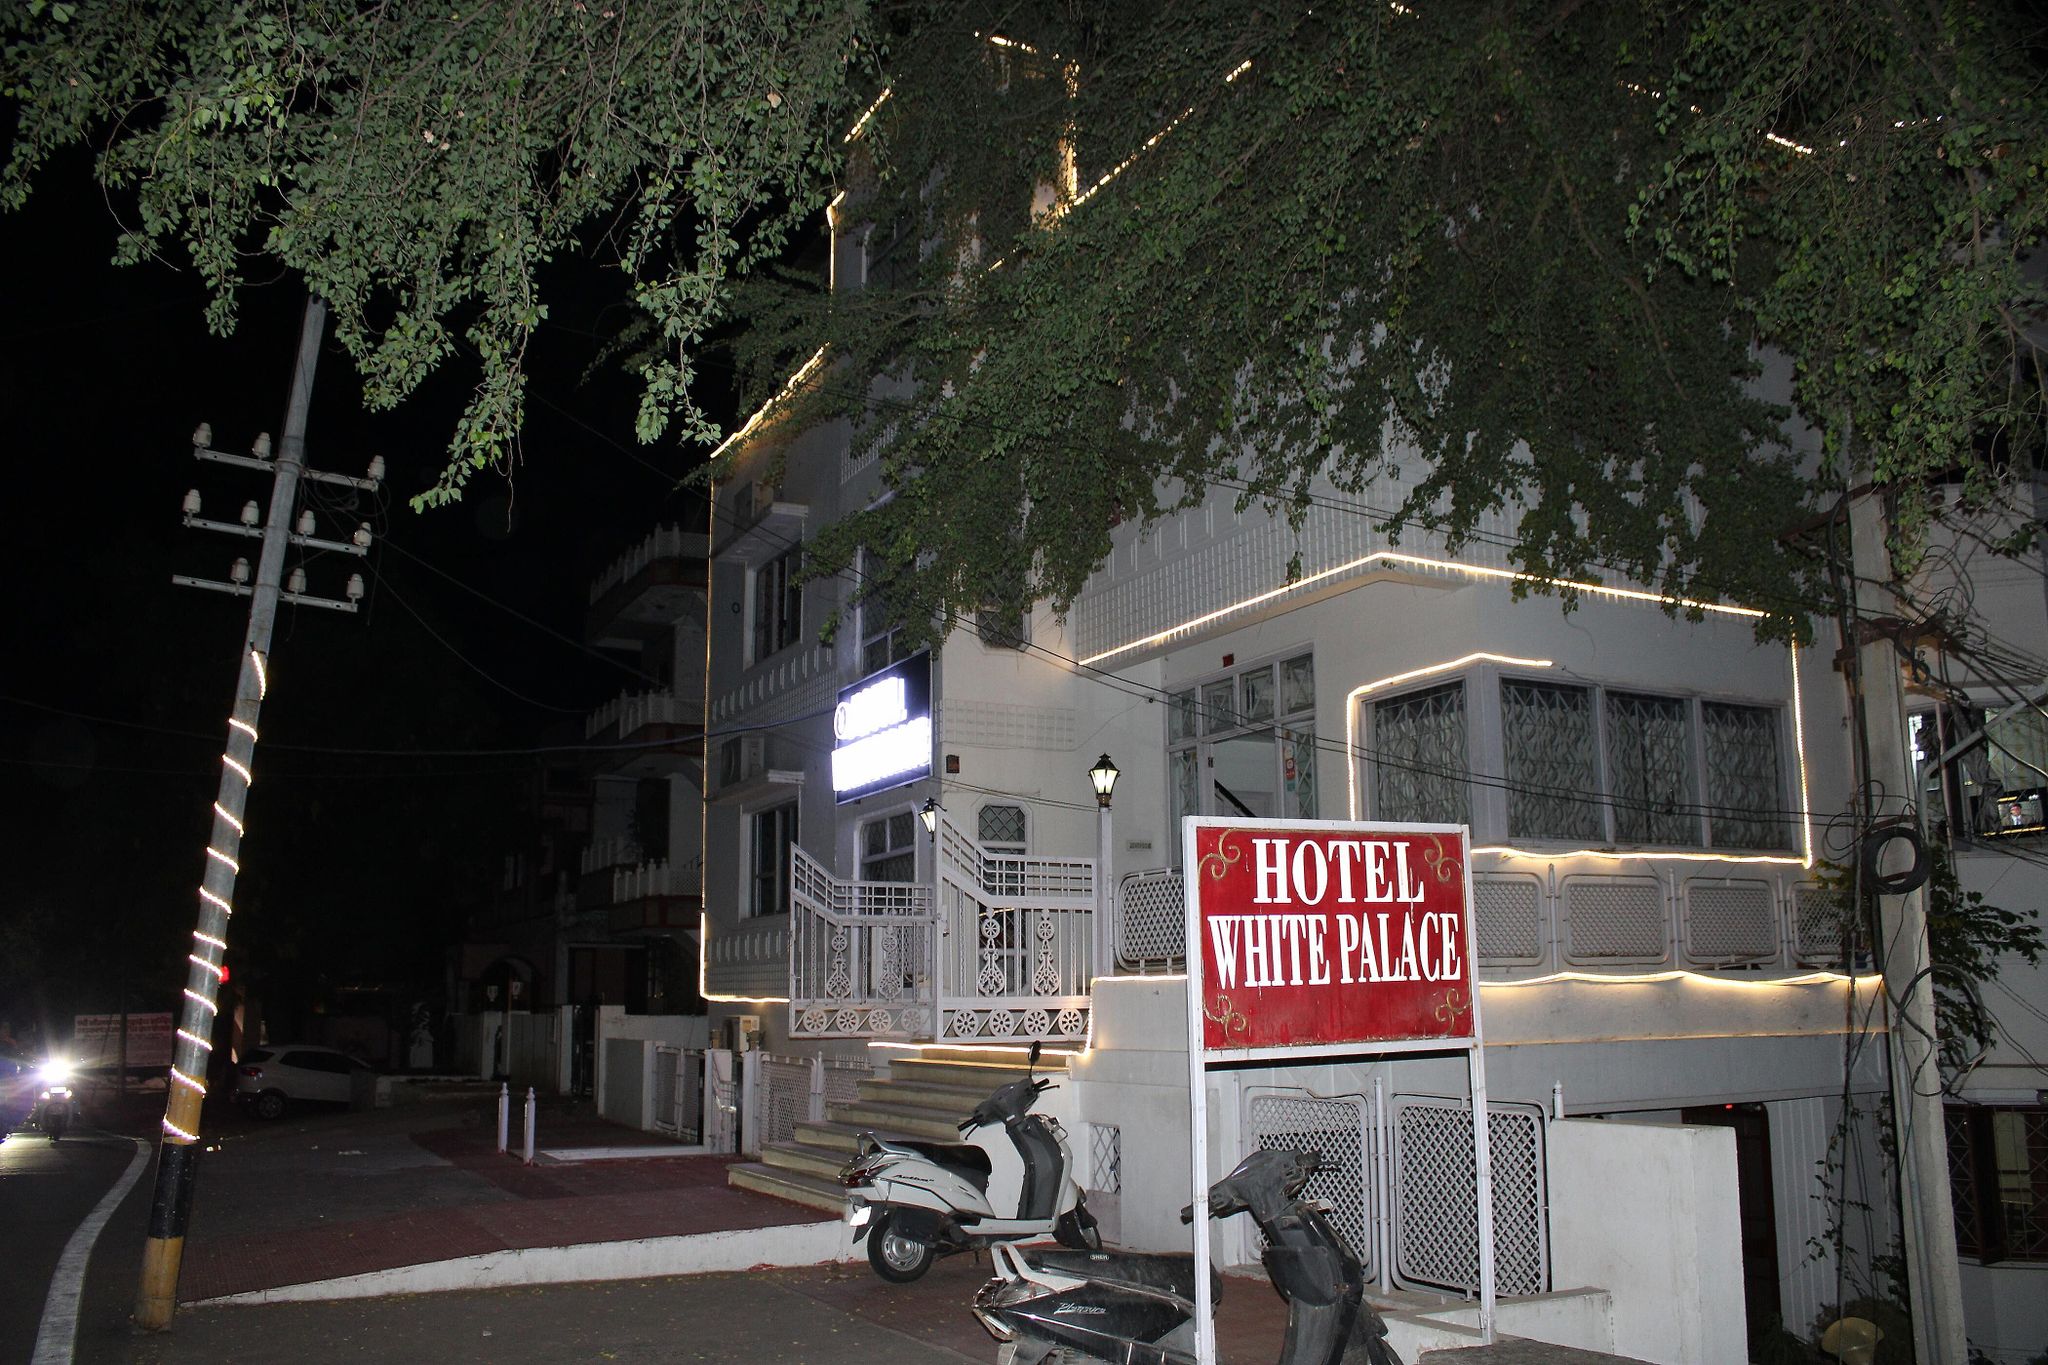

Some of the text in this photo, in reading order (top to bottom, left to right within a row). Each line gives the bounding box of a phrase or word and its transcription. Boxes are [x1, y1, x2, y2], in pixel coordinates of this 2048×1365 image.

[1252, 839, 1425, 905] HOTEL
[1207, 912, 1461, 989] WHITE PALACE
